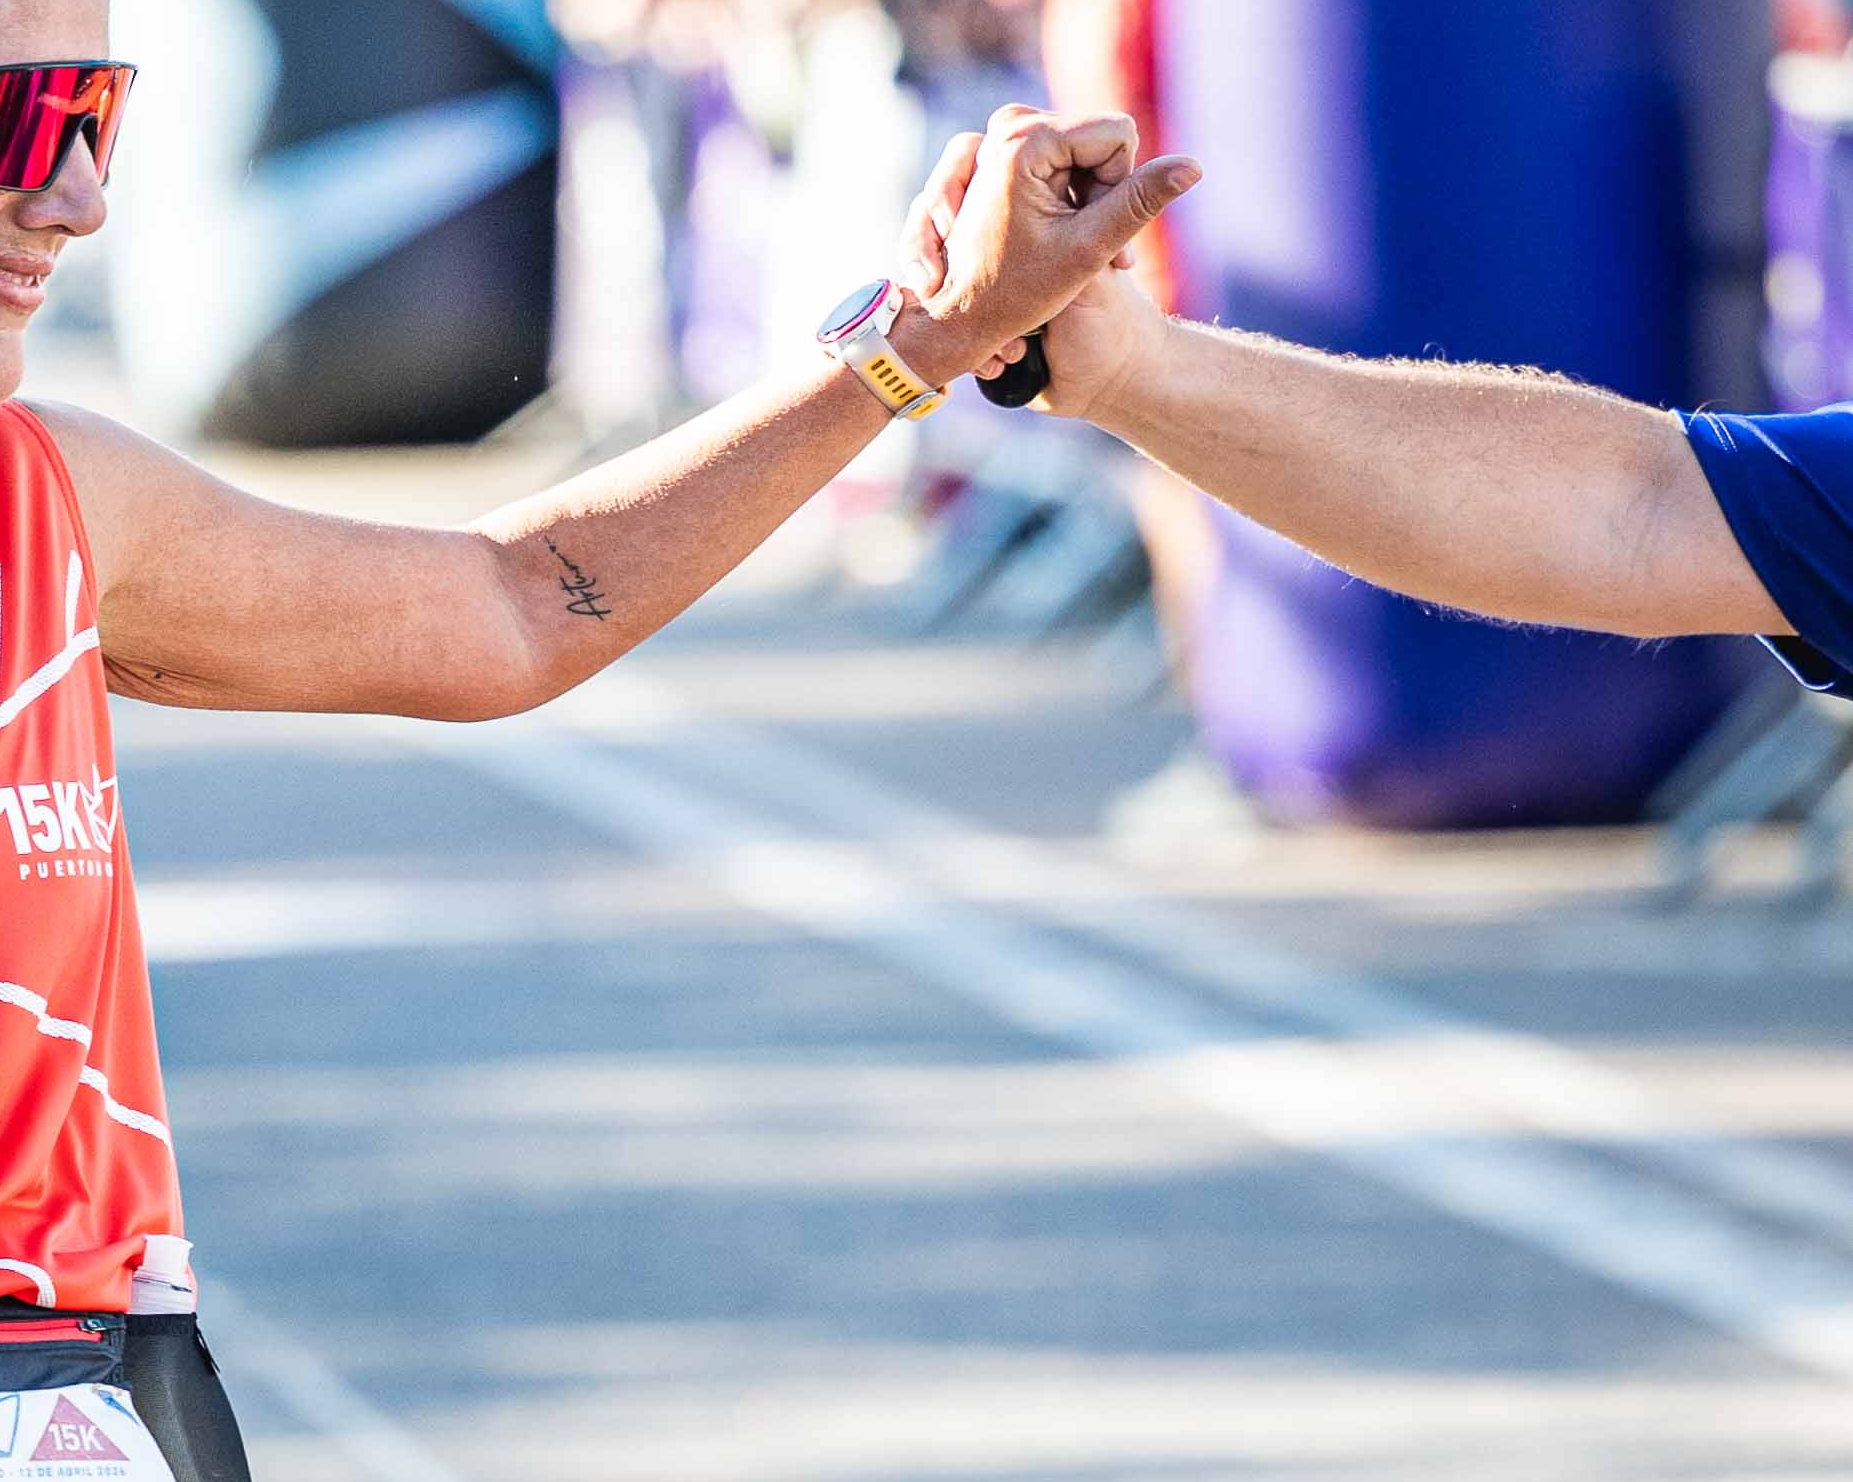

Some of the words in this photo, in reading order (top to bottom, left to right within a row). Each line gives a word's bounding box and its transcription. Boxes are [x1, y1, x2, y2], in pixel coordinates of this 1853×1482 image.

[49, 1423, 102, 1453] 15K
[19, 1467, 32, 1477] 12
[38, 1467, 52, 1477] DE
[57, 1466, 93, 1477] ABRIL
[97, 1465, 126, 1476] 2026
